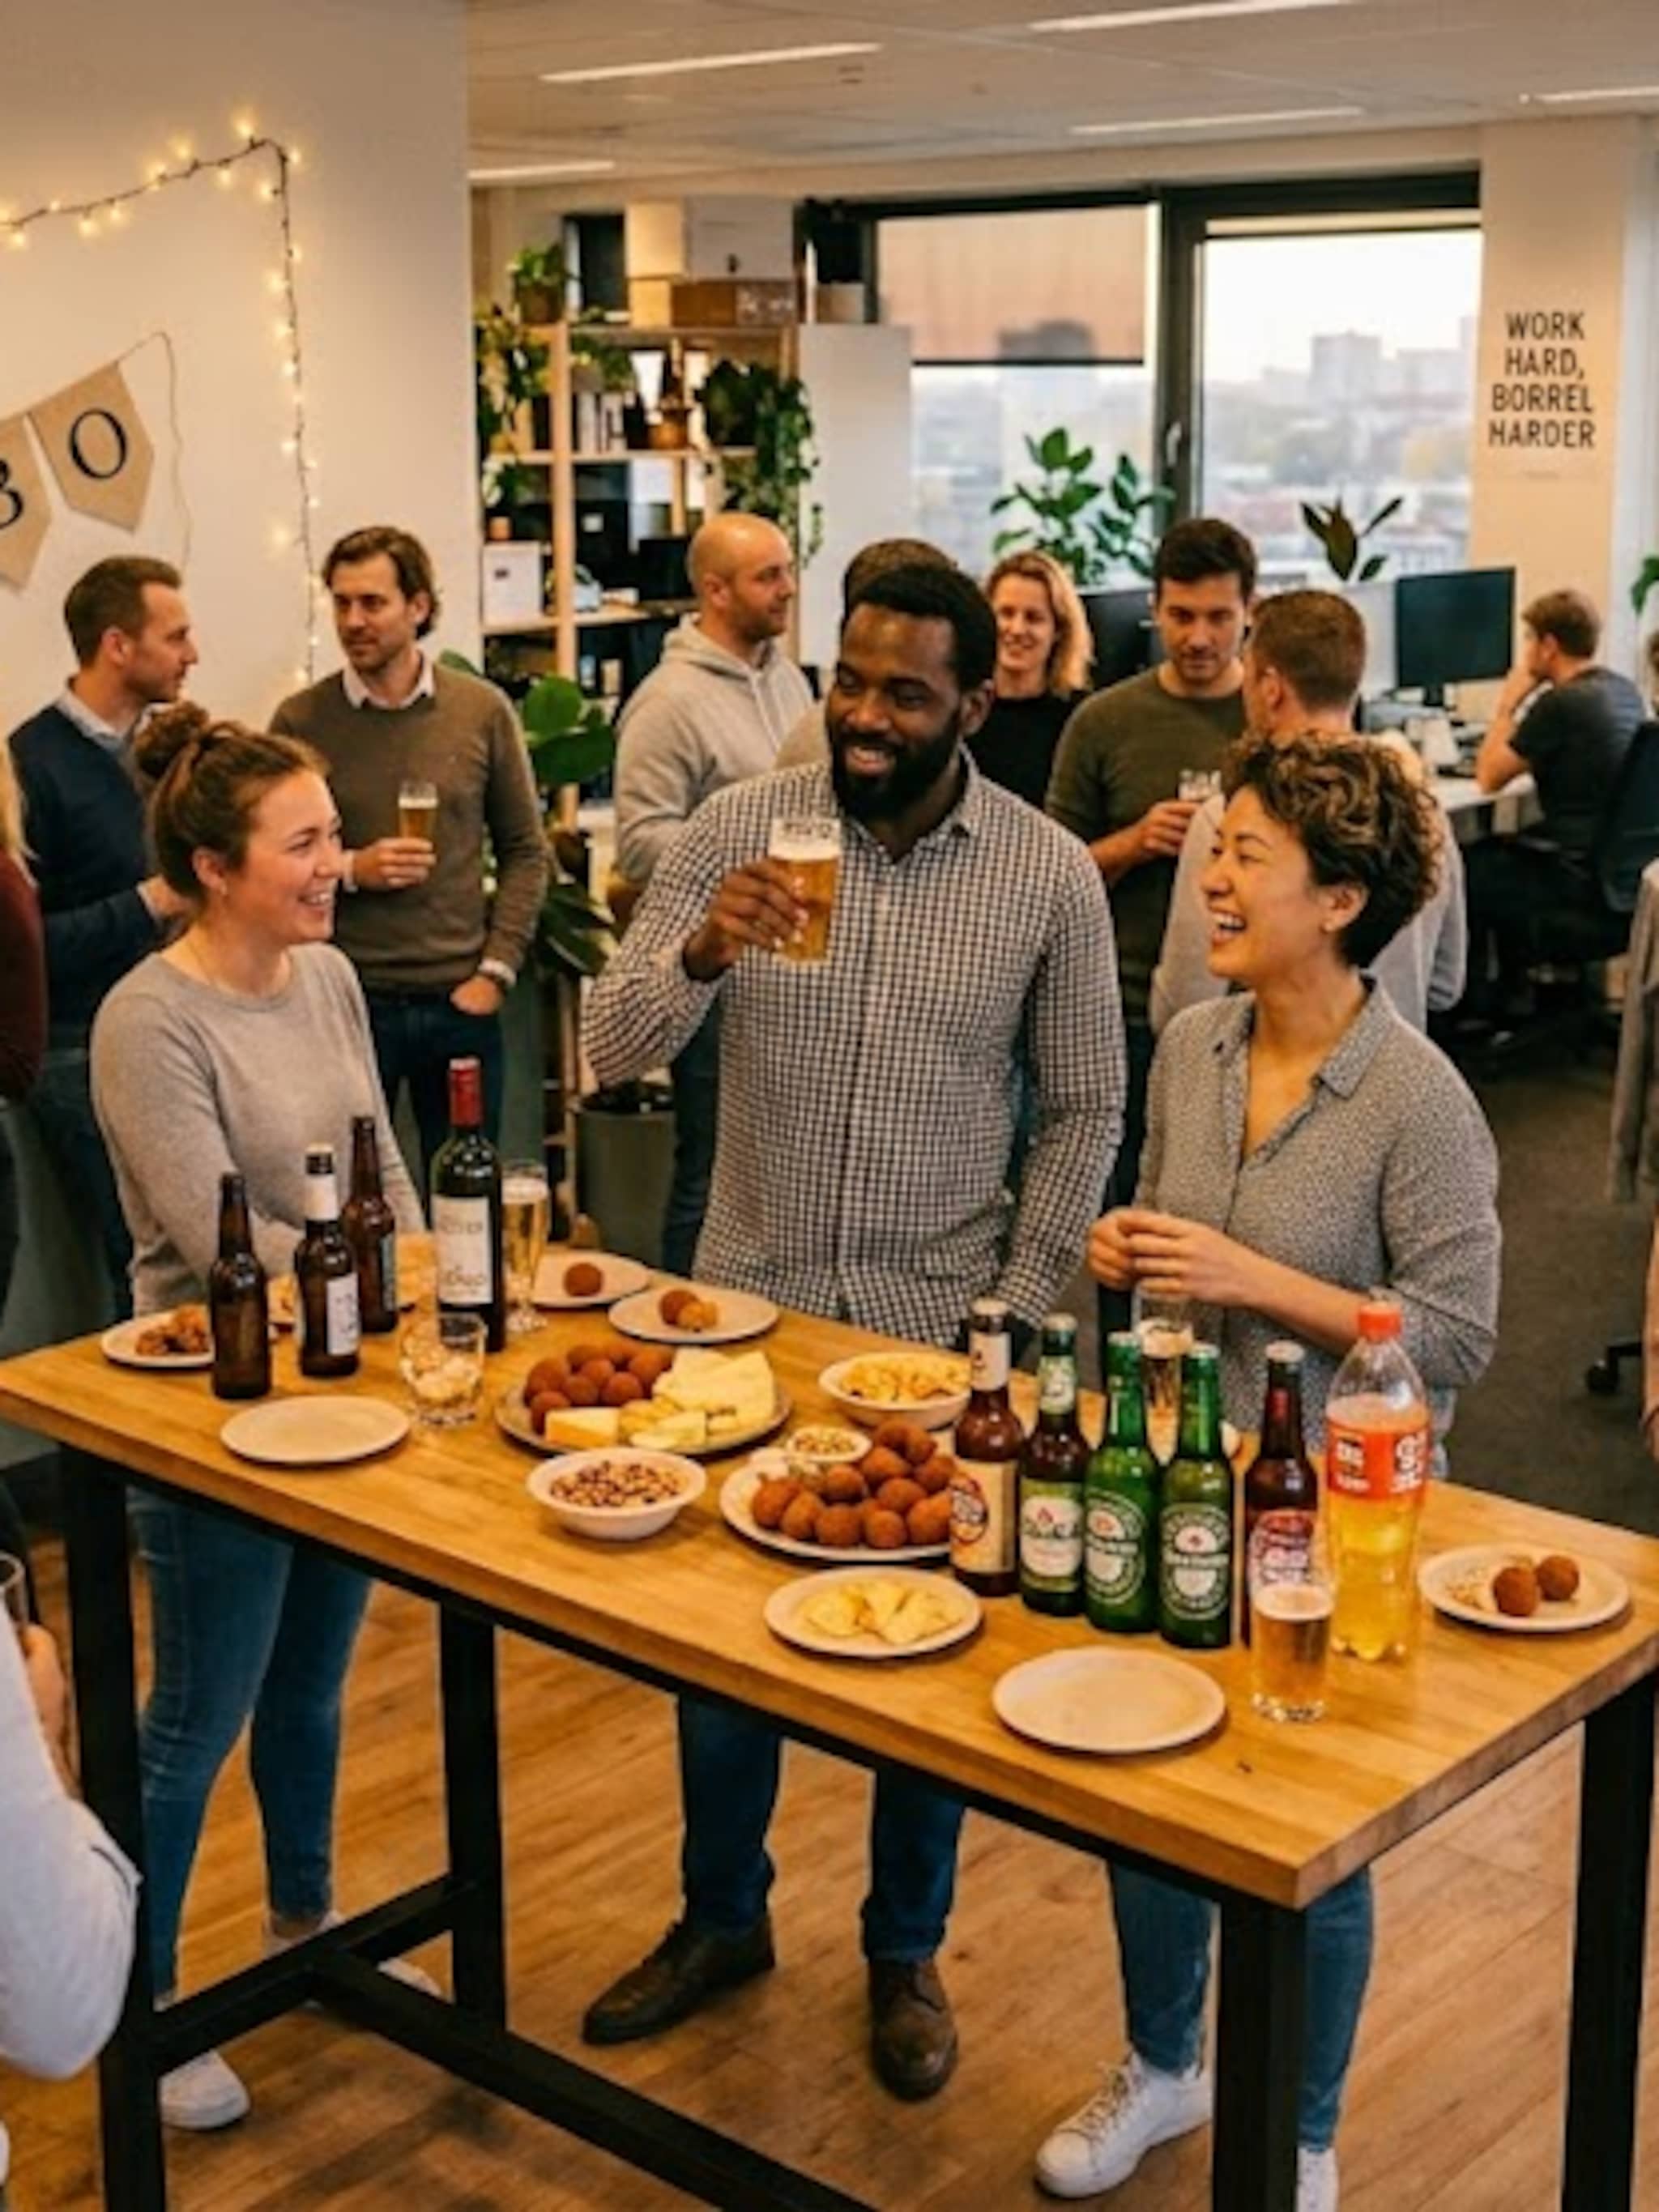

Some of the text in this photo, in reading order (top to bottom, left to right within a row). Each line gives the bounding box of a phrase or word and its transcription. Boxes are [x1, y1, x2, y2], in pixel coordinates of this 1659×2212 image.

[1506, 311, 1584, 340] WORK
[1504, 347, 1584, 380] HARD,
[1491, 383, 1593, 414] BORREL
